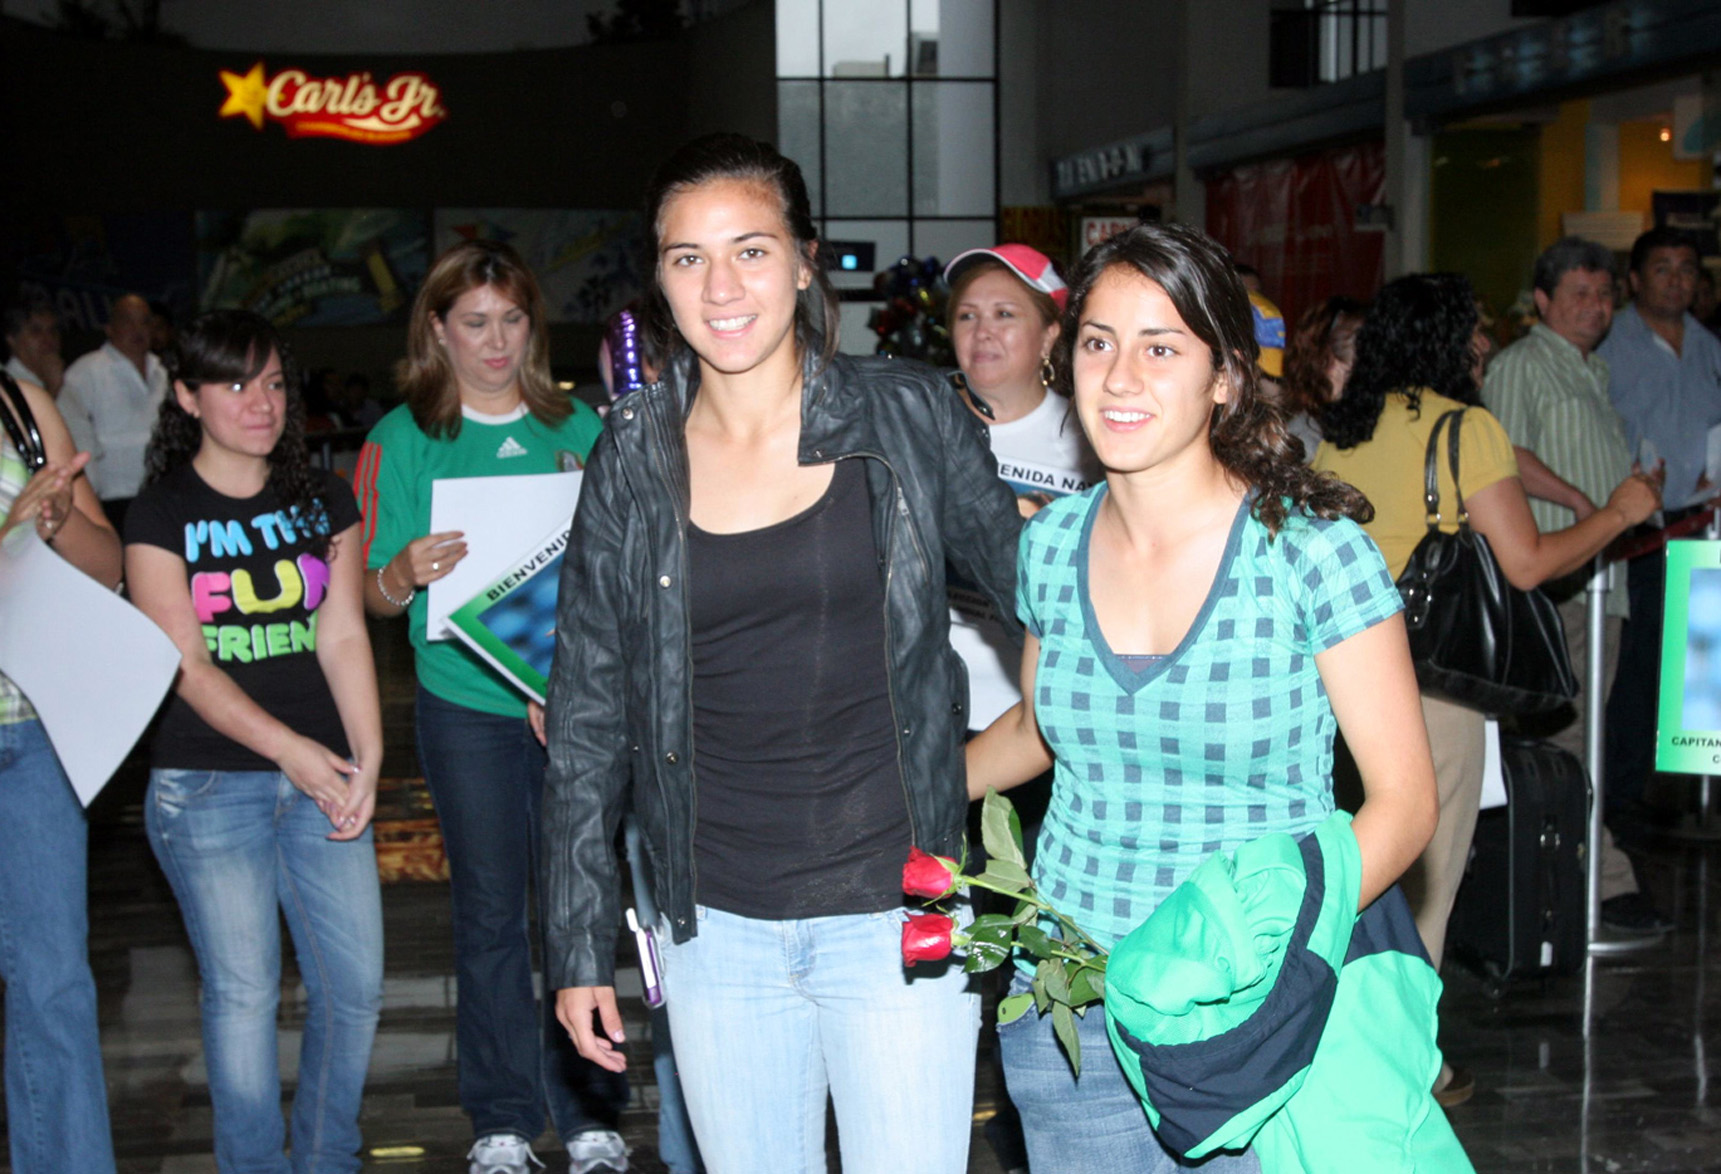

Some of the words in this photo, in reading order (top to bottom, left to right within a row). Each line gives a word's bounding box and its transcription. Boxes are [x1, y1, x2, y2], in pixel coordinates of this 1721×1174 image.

[266, 70, 382, 117] Carl's
[1000, 463, 1055, 486] ENIDA
[185, 519, 253, 563] I'M
[191, 553, 330, 622] FUN
